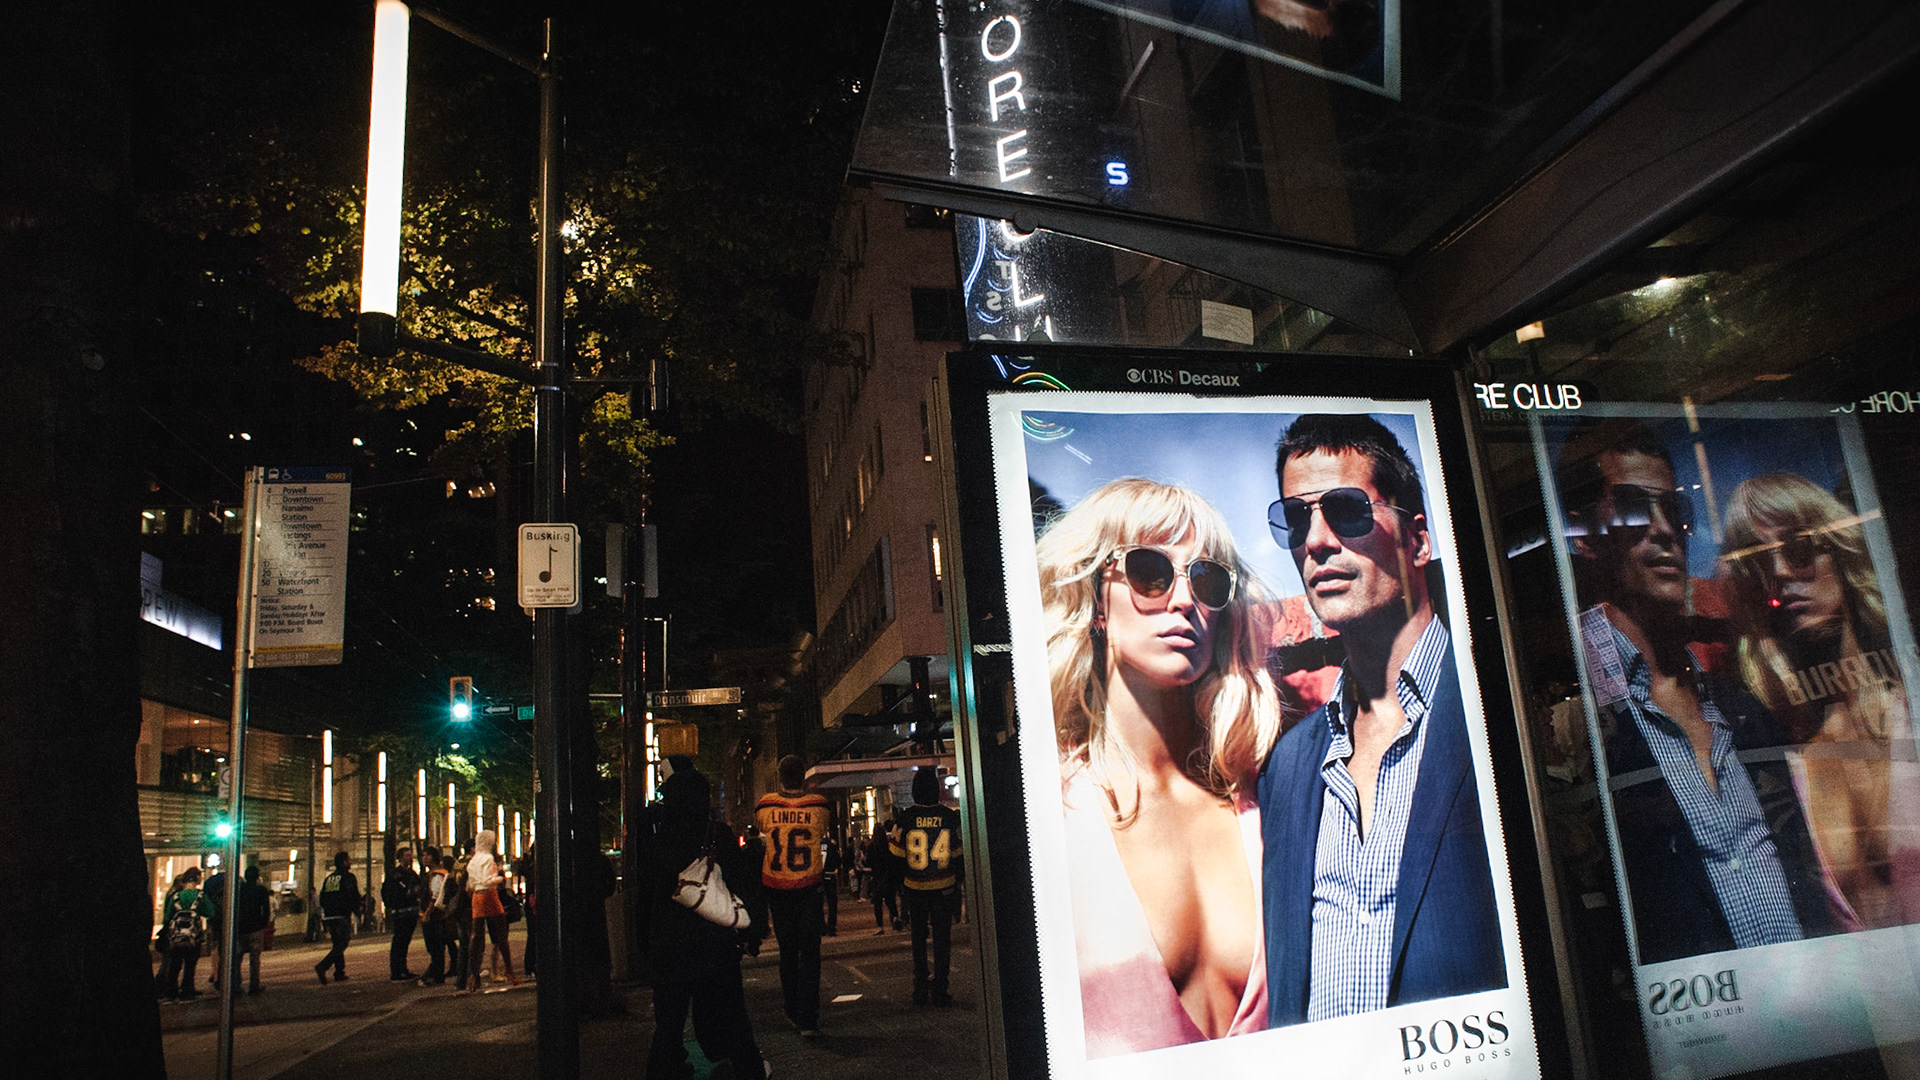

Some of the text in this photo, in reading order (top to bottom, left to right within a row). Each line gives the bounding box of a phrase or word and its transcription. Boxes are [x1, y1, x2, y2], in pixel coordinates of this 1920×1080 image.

[1512, 381, 1584, 411] CLUB
[282, 486, 308, 494] Powell
[282, 496, 324, 504] Downtown
[278, 578, 320, 586] Waterfront
[277, 588, 304, 596] Station
[771, 811, 812, 824] LINDEN
[915, 816, 943, 828] BARZY
[770, 827, 812, 872] 16
[1398, 1010, 1510, 1062] BOSS
[1404, 1048, 1512, 1076] HUGO BOSS
